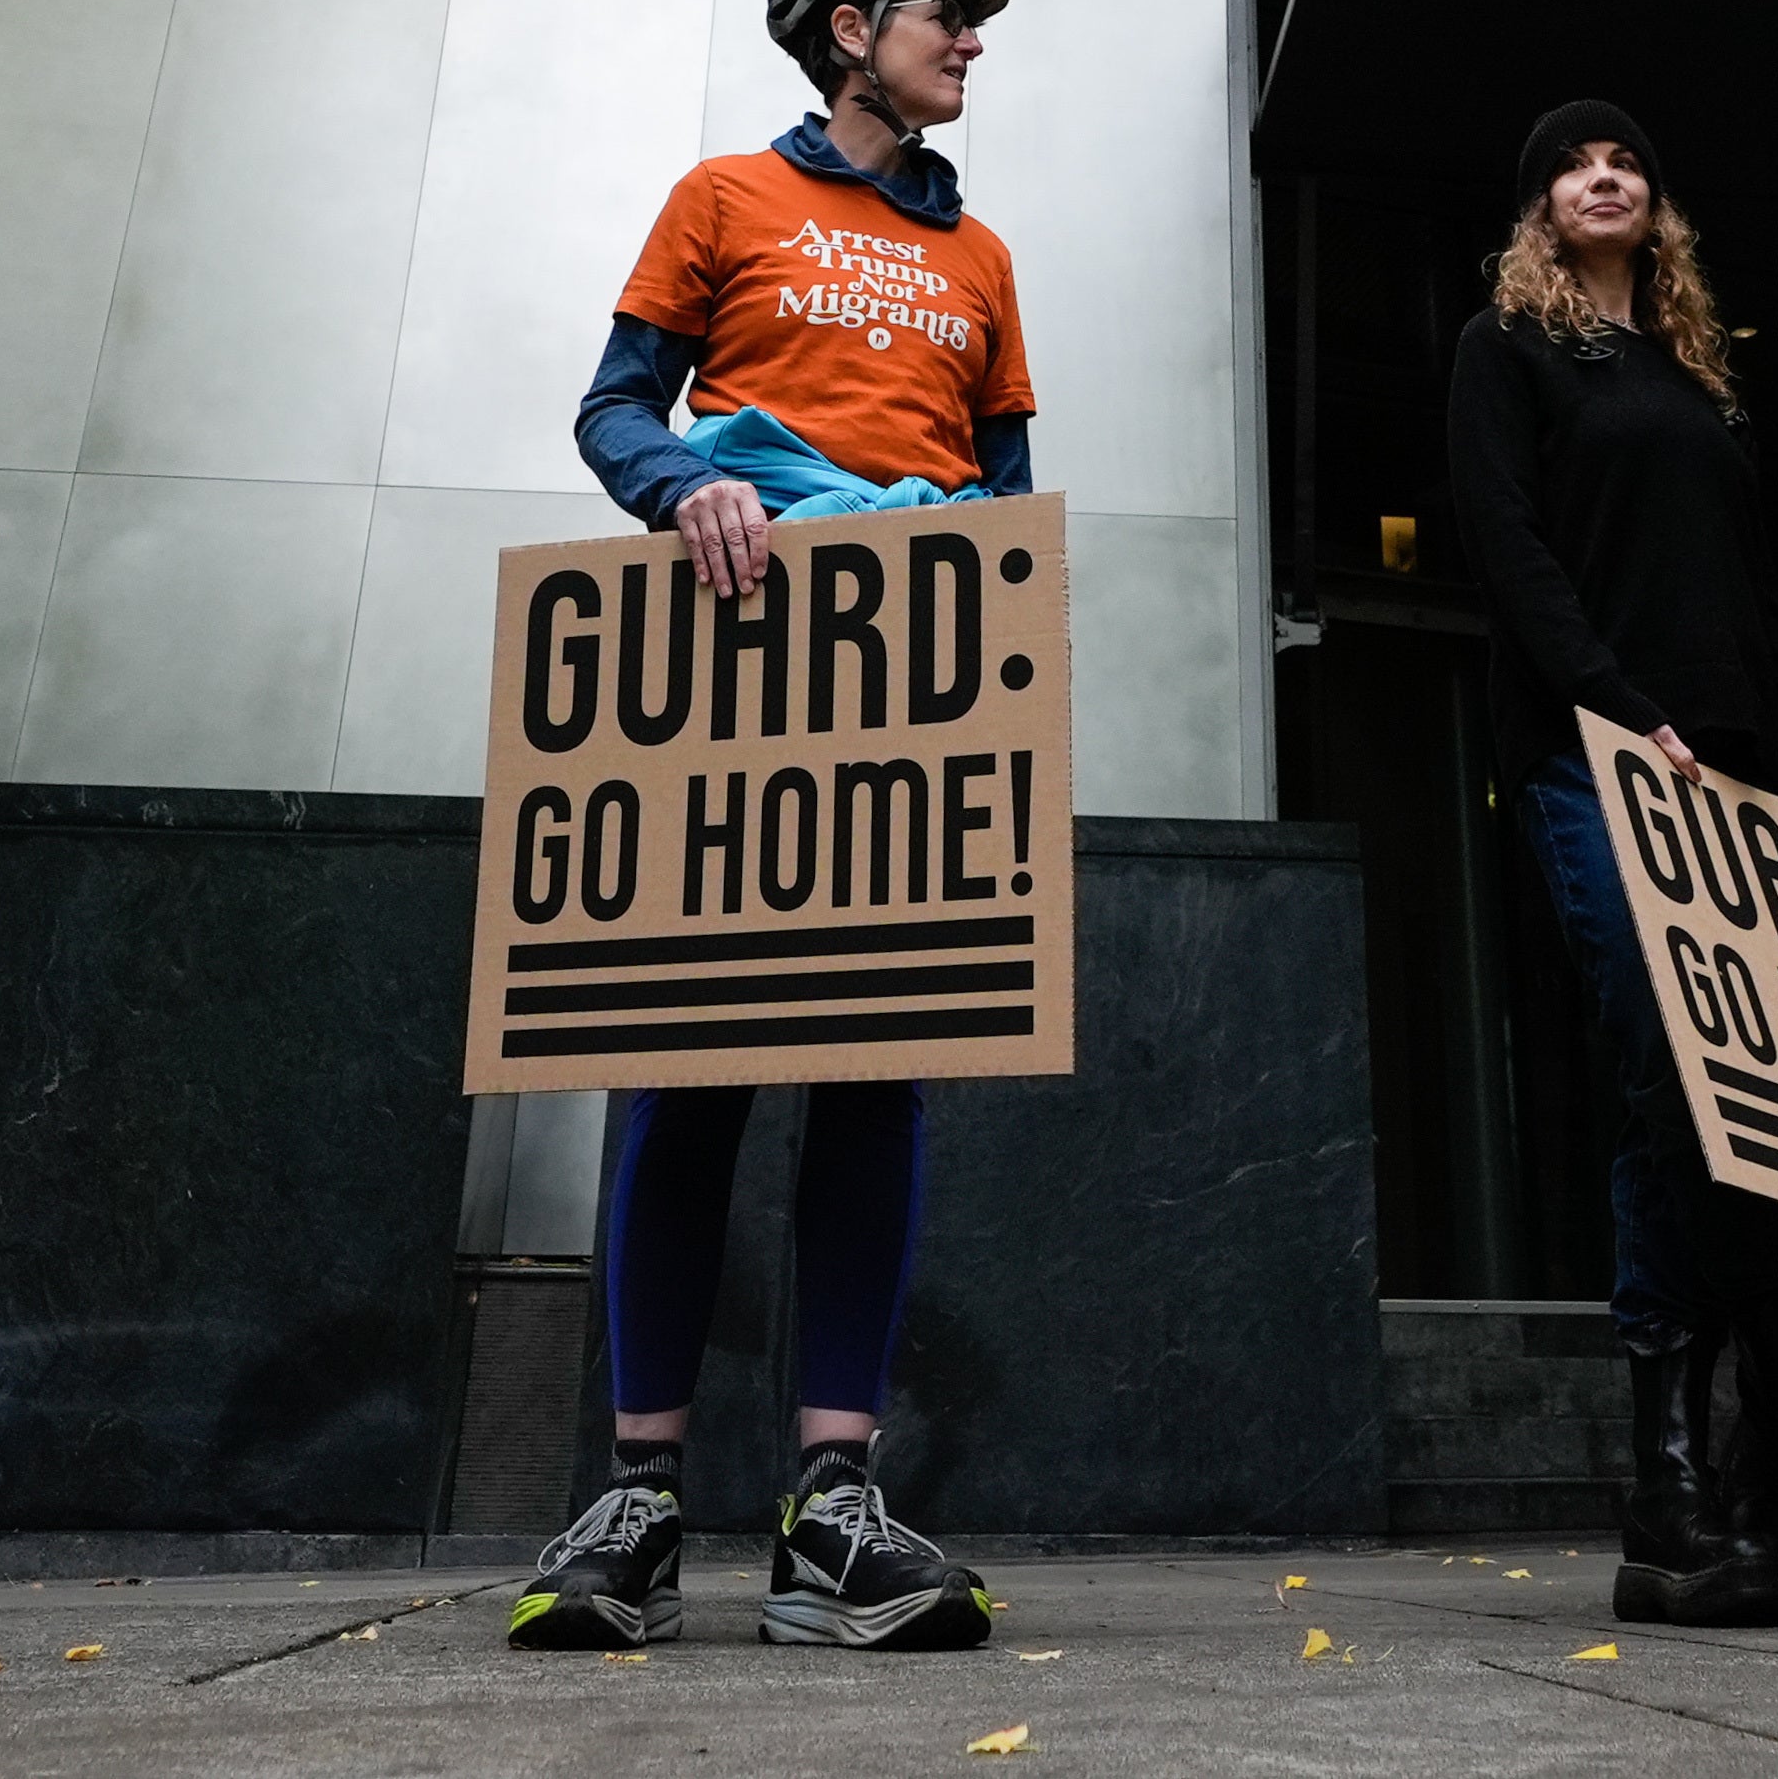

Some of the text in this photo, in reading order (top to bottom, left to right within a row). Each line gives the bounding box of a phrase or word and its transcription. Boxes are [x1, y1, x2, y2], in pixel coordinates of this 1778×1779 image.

[778, 218, 927, 264] Arrest
[801, 241, 949, 298] Trump
[775, 283, 971, 352] Migrants
[848, 272, 918, 302] Not
[523, 532, 1034, 754] GUARD:
[512, 750, 1034, 925] GO HOME!
[1666, 925, 1777, 1066] GO
